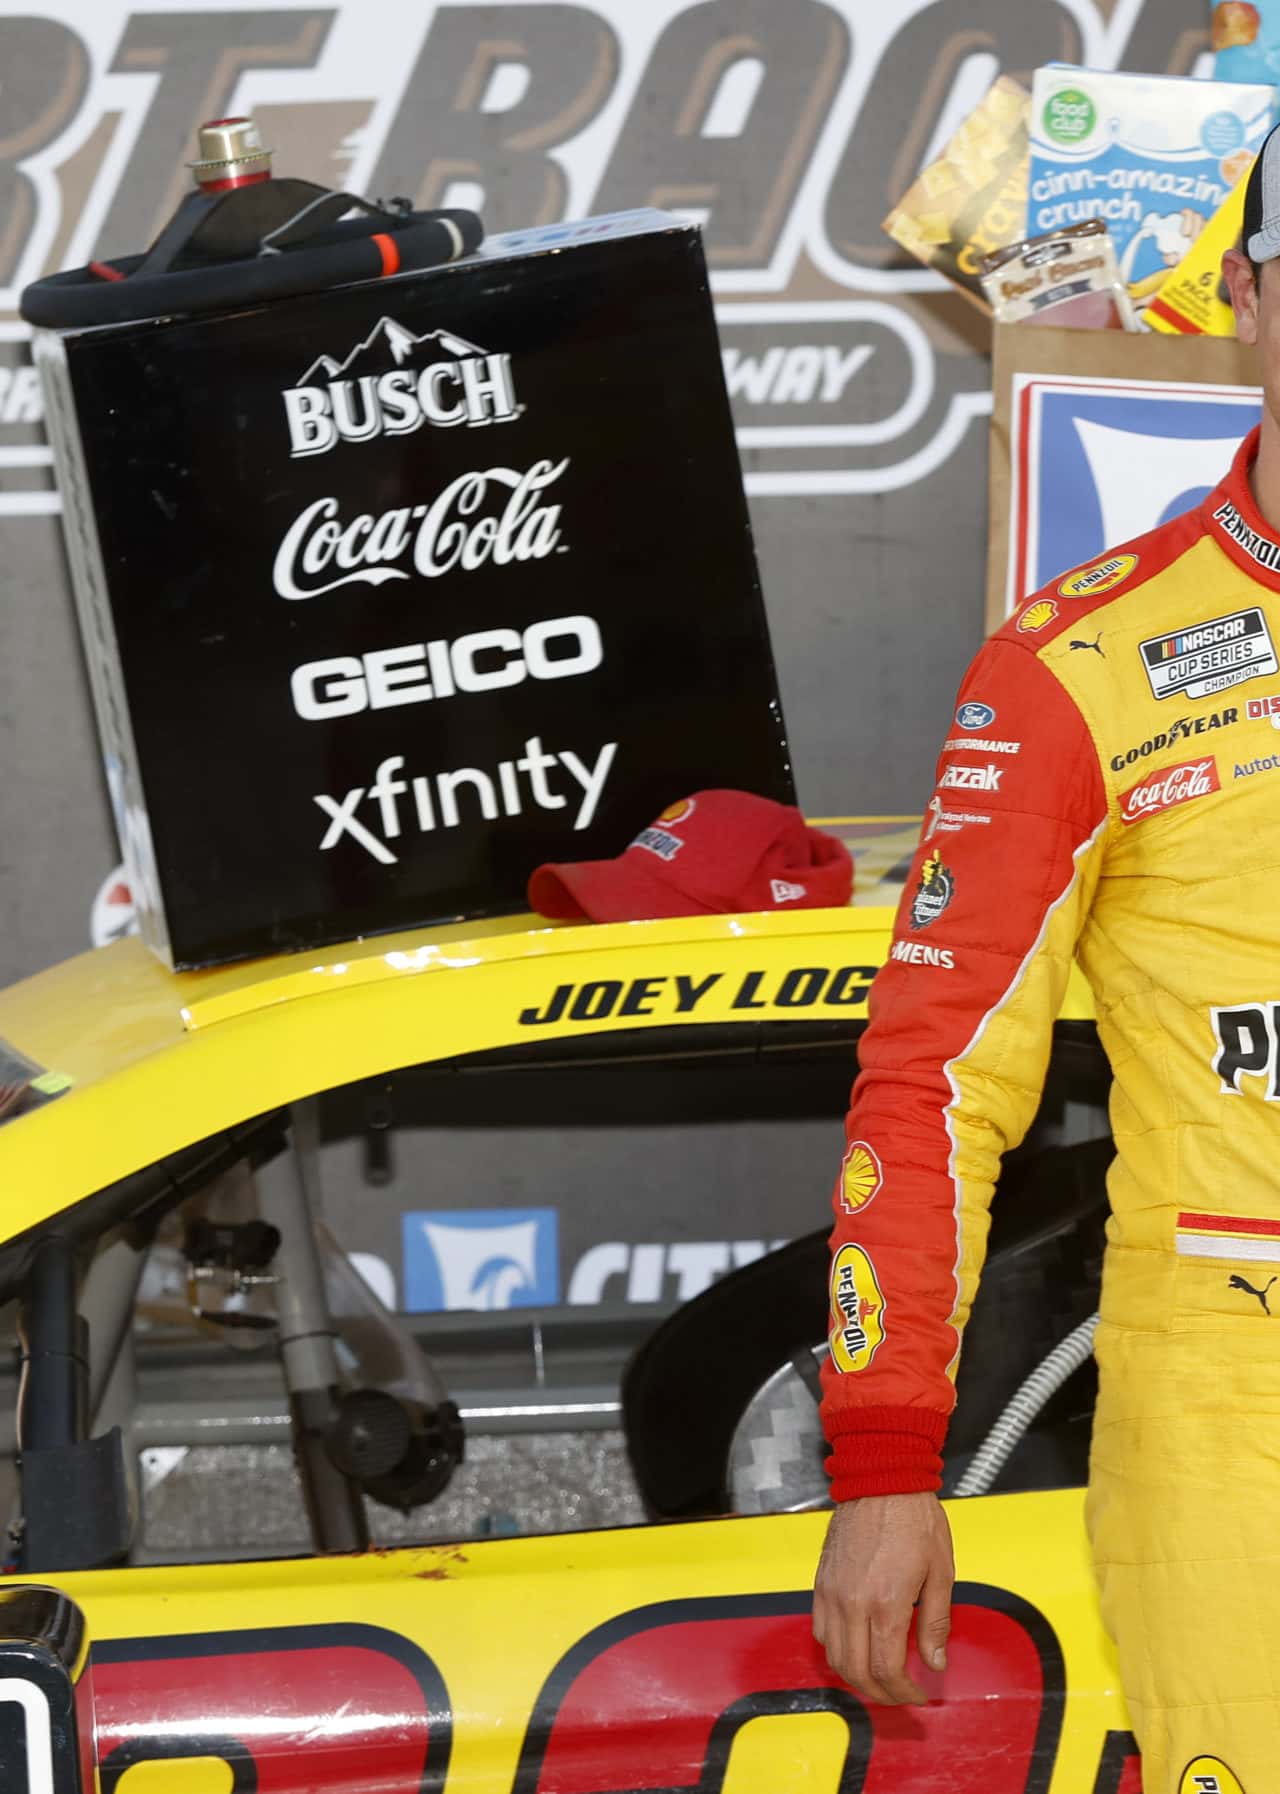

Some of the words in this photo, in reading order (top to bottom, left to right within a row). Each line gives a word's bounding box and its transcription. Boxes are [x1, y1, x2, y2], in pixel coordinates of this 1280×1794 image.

[1037, 192, 1142, 229] crunch
[1198, 271, 1215, 287] 6
[283, 353, 520, 458] BUSCH
[273, 457, 570, 600] Coca-Cola
[1071, 560, 1124, 592] PENNZOIL
[1182, 618, 1246, 652] NASCAR
[290, 615, 603, 720] GEICO
[1168, 658, 1198, 682] CUP
[1200, 642, 1253, 670] SERIES
[1204, 666, 1260, 692] CHAMPION
[961, 705, 987, 725] Ford
[938, 764, 1003, 790] azak
[1122, 760, 1214, 821] oca-Cola
[313, 736, 618, 864] xfinity
[519, 972, 724, 1025] JOEY
[731, 965, 880, 1009] LOG
